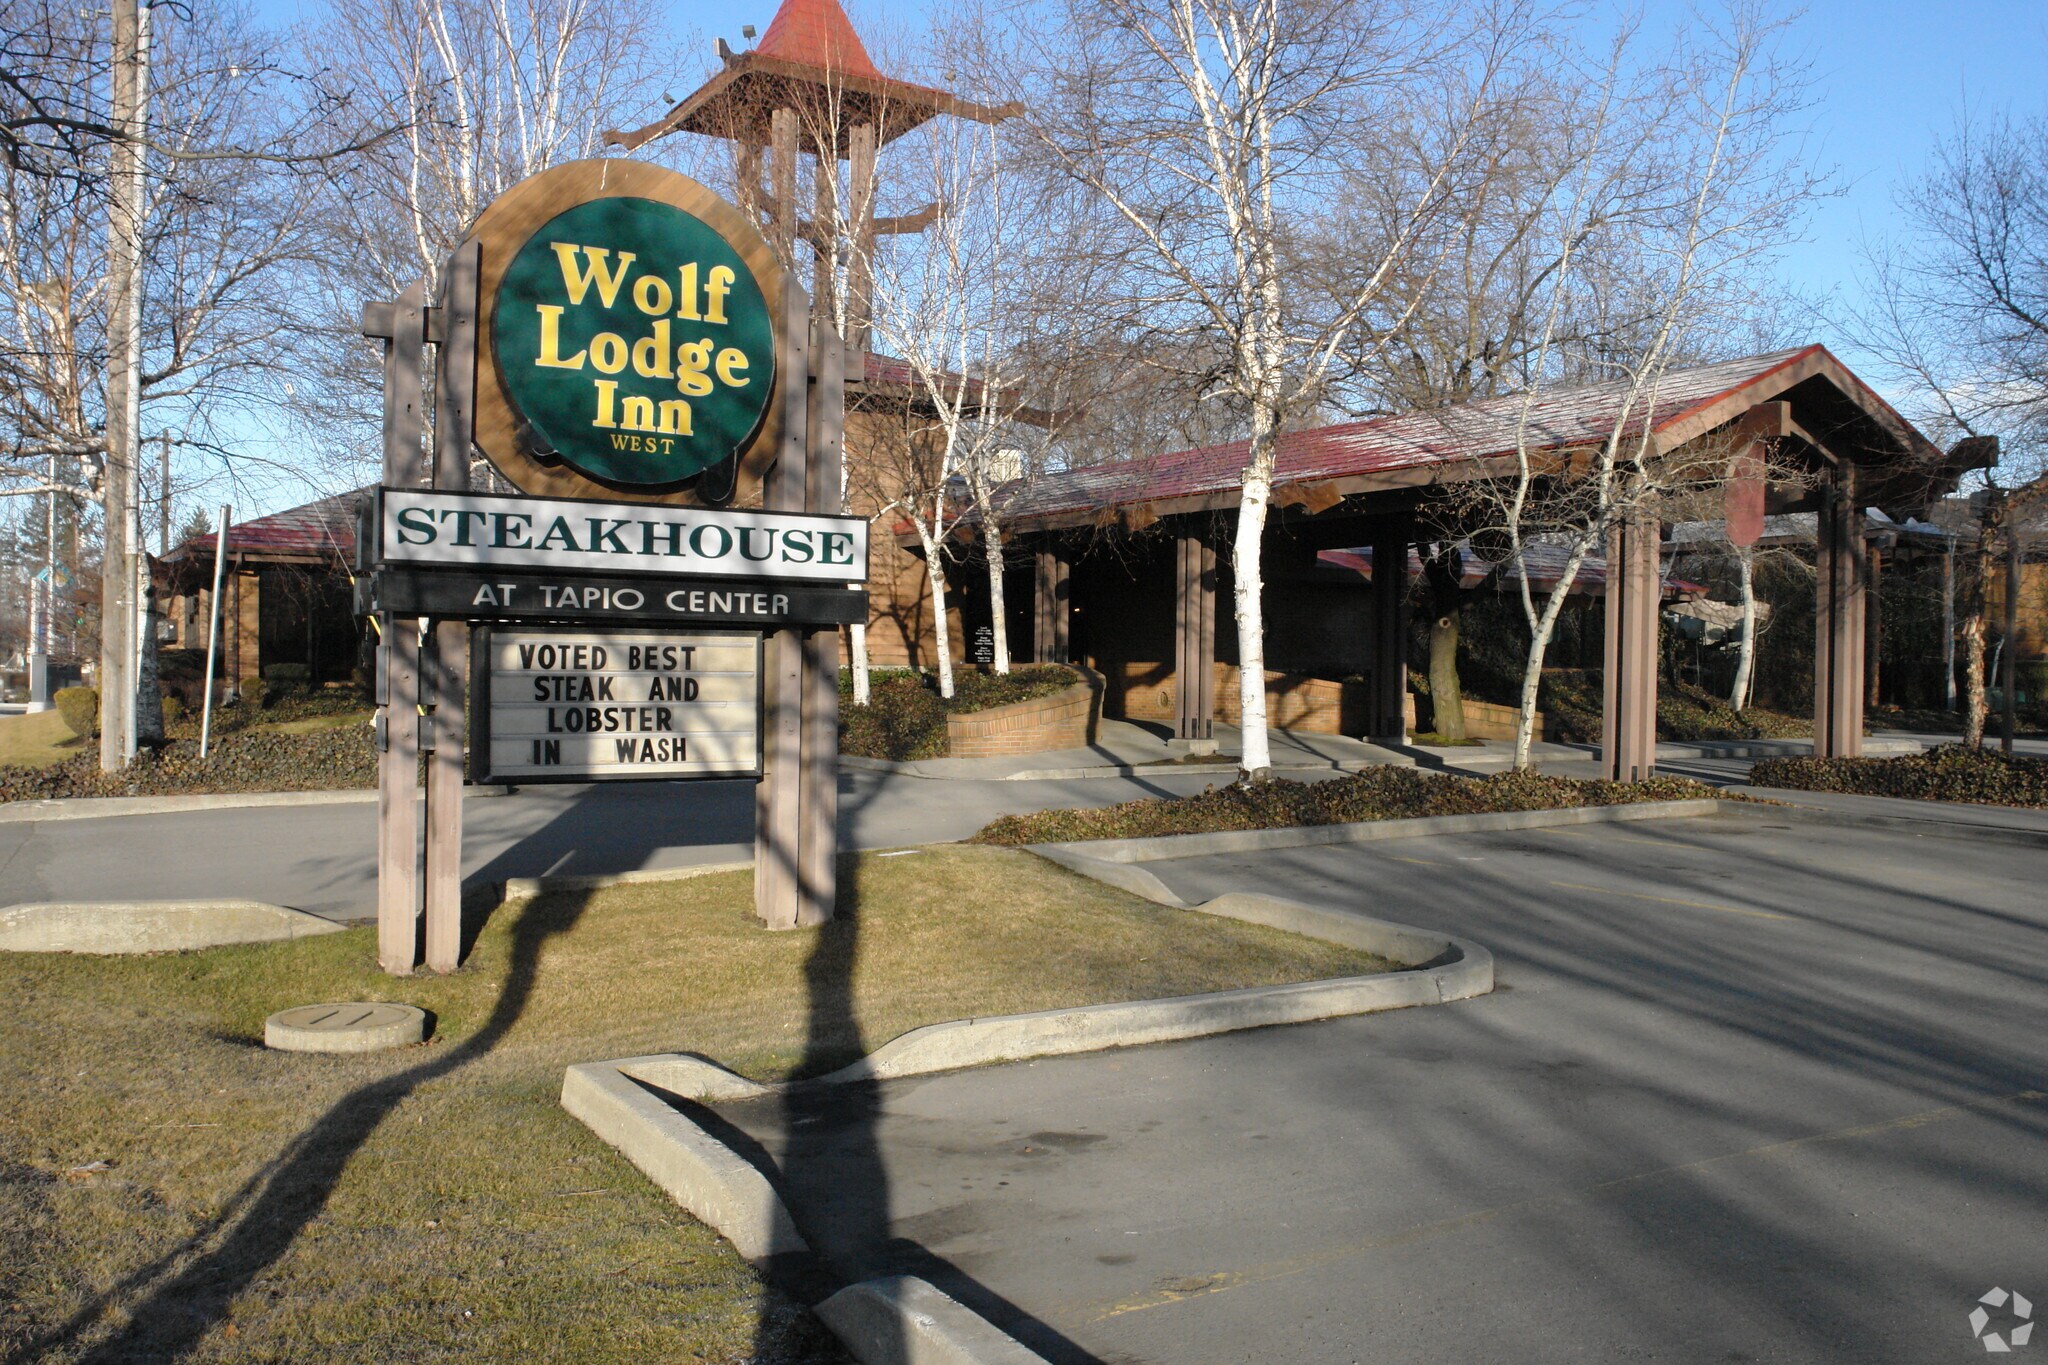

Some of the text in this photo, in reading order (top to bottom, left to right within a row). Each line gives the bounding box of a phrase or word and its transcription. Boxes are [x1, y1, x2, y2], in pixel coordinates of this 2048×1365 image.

[550, 241, 736, 325] Wolf
[535, 303, 750, 397] Lodge
[592, 379, 694, 436] Inn
[610, 433, 675, 455] WEST
[397, 507, 854, 565] STEAKHOUSE
[473, 584, 789, 616] AT TAPIO CENTER
[518, 644, 696, 671] VOTED BEST
[534, 676, 700, 702] STEAK AND
[548, 707, 672, 733] LOBSTER
[532, 738, 687, 765] IN WASH
